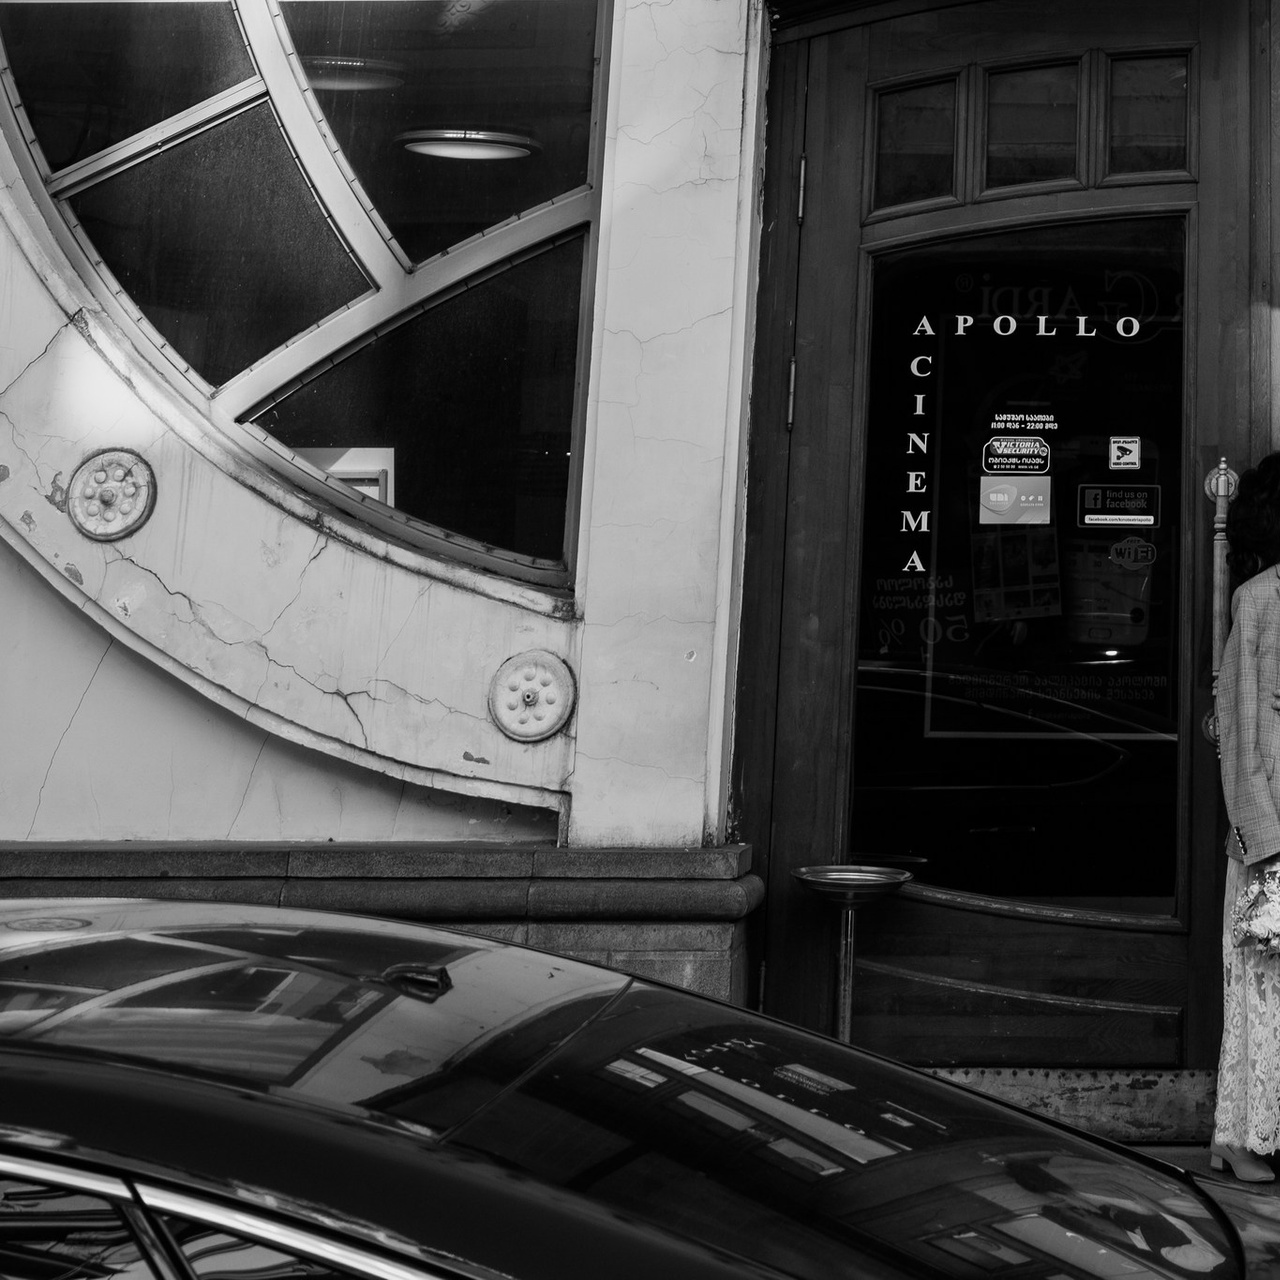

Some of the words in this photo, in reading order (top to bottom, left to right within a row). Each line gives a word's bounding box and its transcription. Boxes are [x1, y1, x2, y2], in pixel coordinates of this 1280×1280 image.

[913, 316, 1139, 337] APOLLO
[900, 355, 931, 572] CINEMA
[1124, 491, 1135, 499] us
[1106, 498, 1148, 509] facebook
